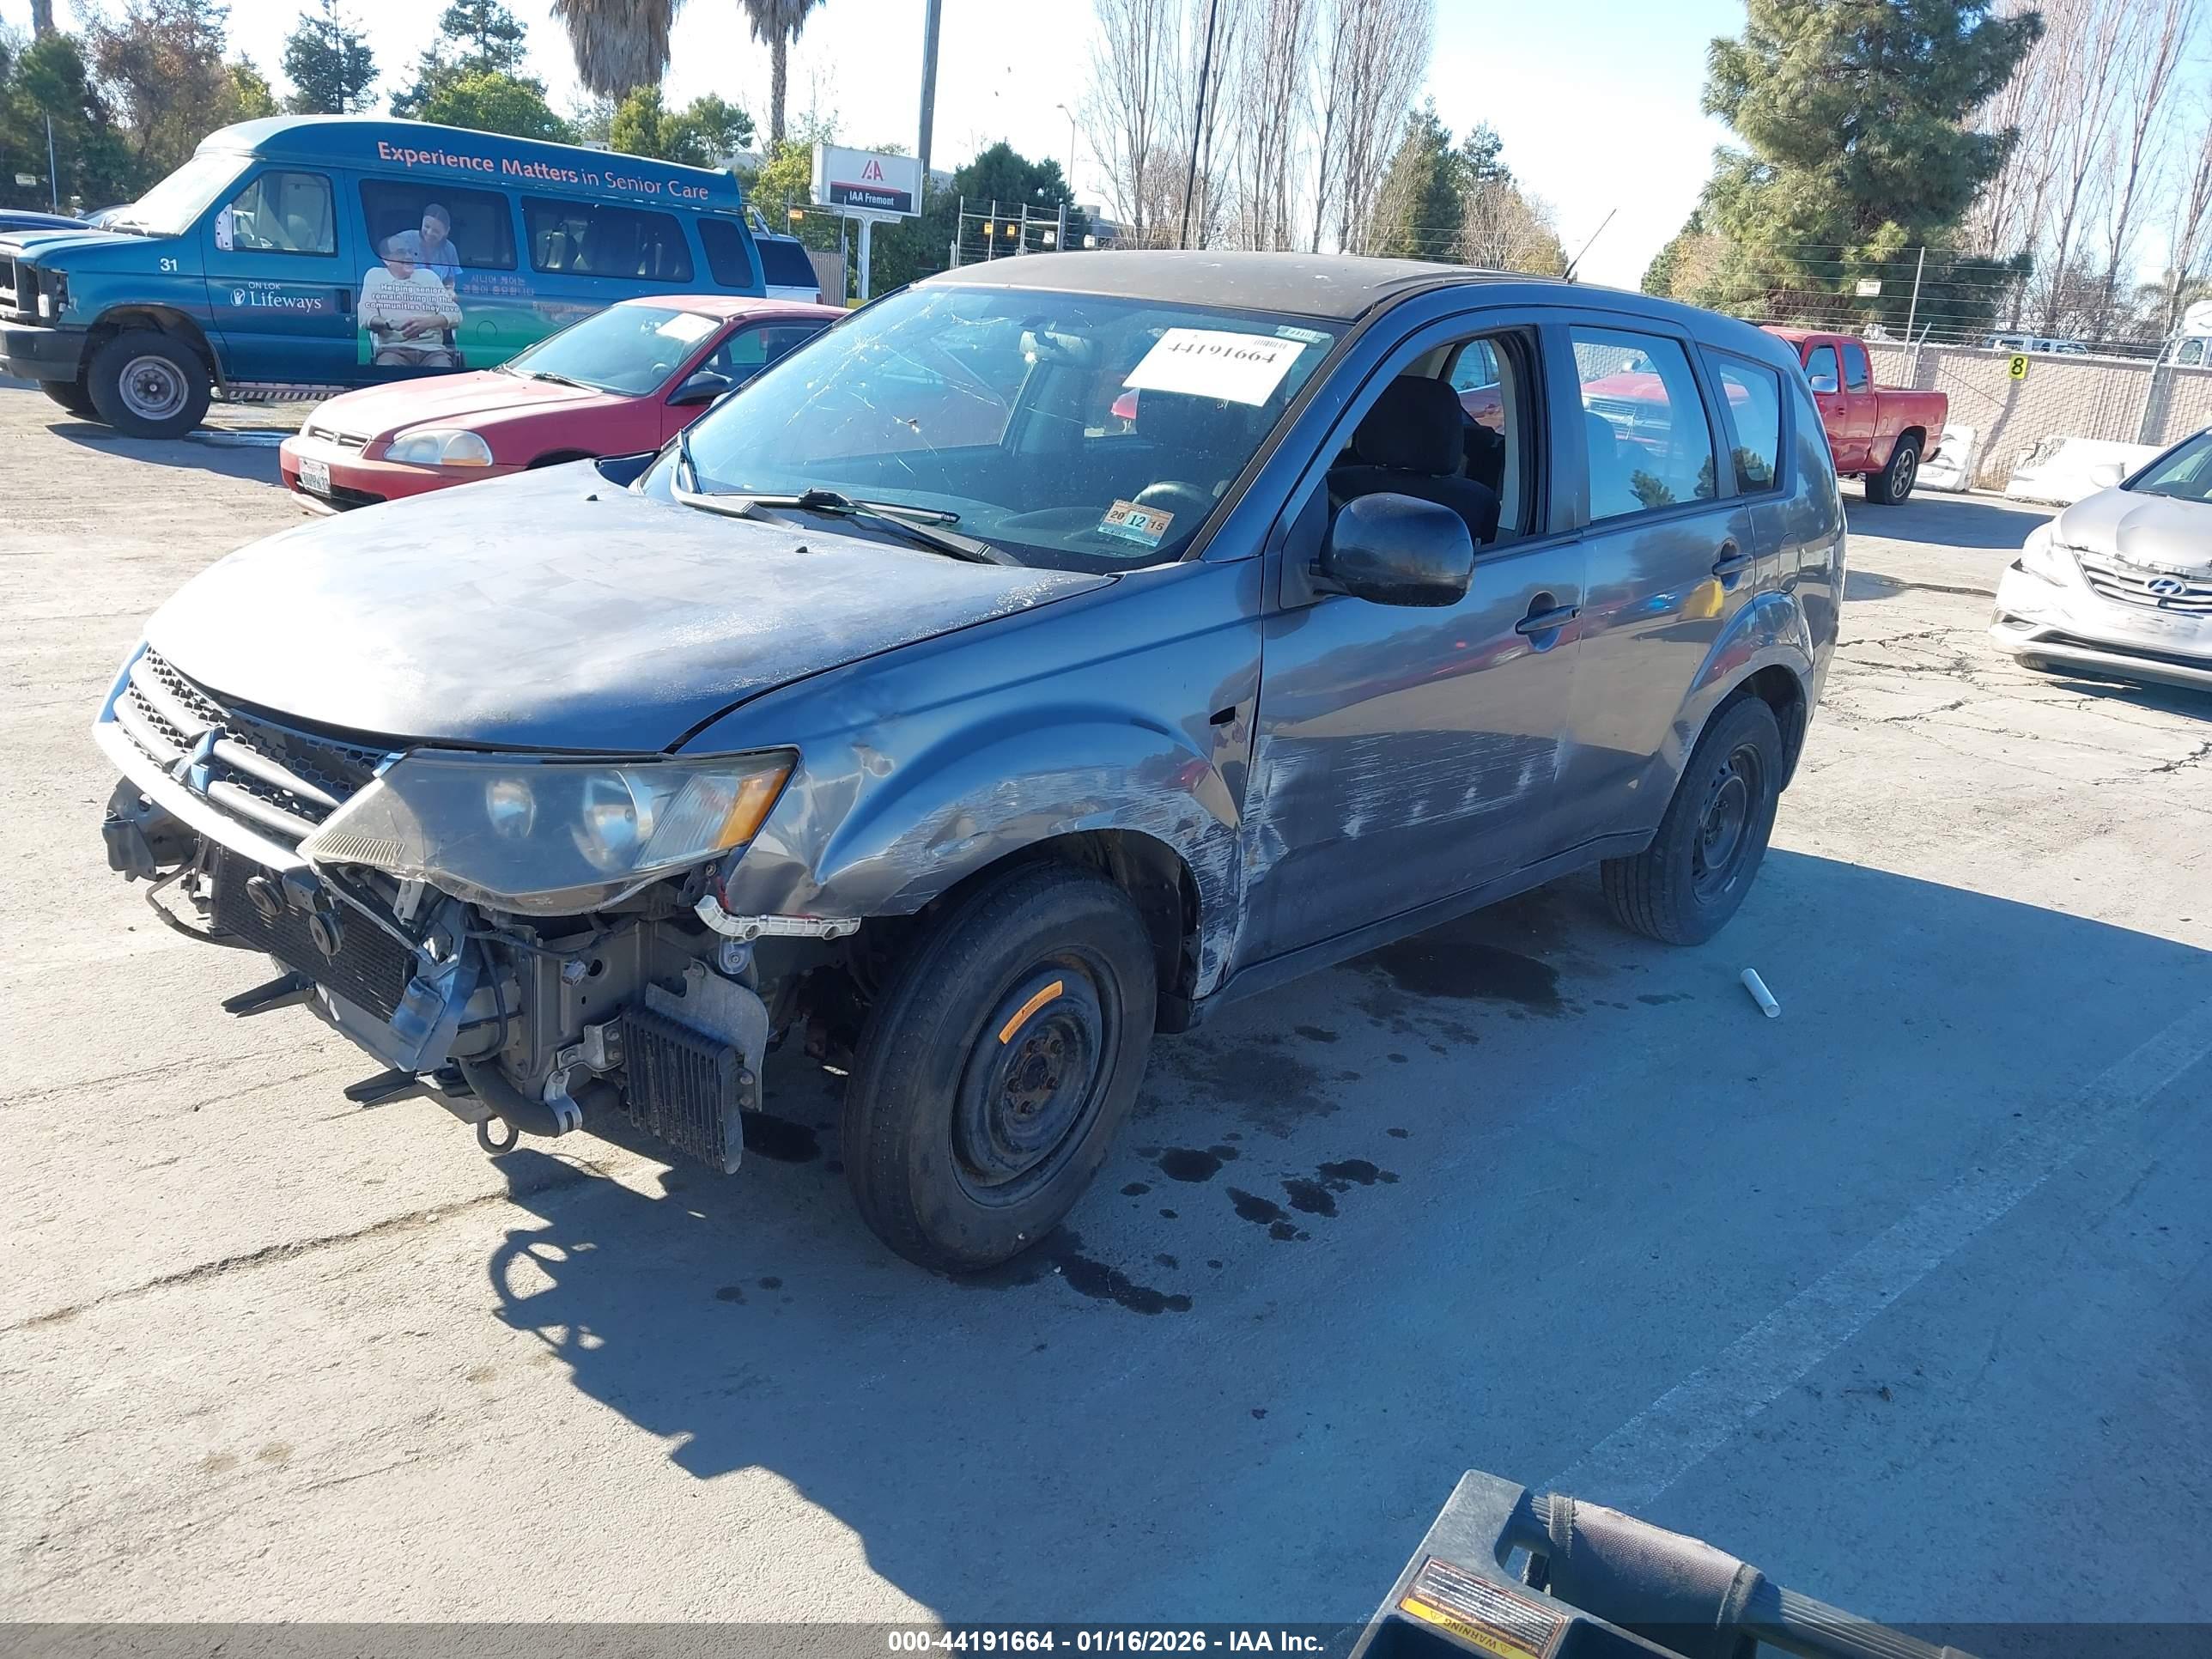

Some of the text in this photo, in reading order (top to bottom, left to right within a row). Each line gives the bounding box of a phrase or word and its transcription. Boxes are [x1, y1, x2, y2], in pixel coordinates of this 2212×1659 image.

[378, 141, 708, 199] Experience Matters in Senior Care
[849, 190, 895, 206] IAA Fremont
[160, 258, 178, 271] 31
[380, 283, 413, 294] Helping
[250, 291, 322, 313] Lifeways
[422, 304, 441, 313] they
[1168, 342, 1277, 363] 44191664
[2011, 357, 2024, 375] 8
[1110, 510, 1165, 531] 20 12 15
[1443, 1618, 1497, 1650] WARNING
